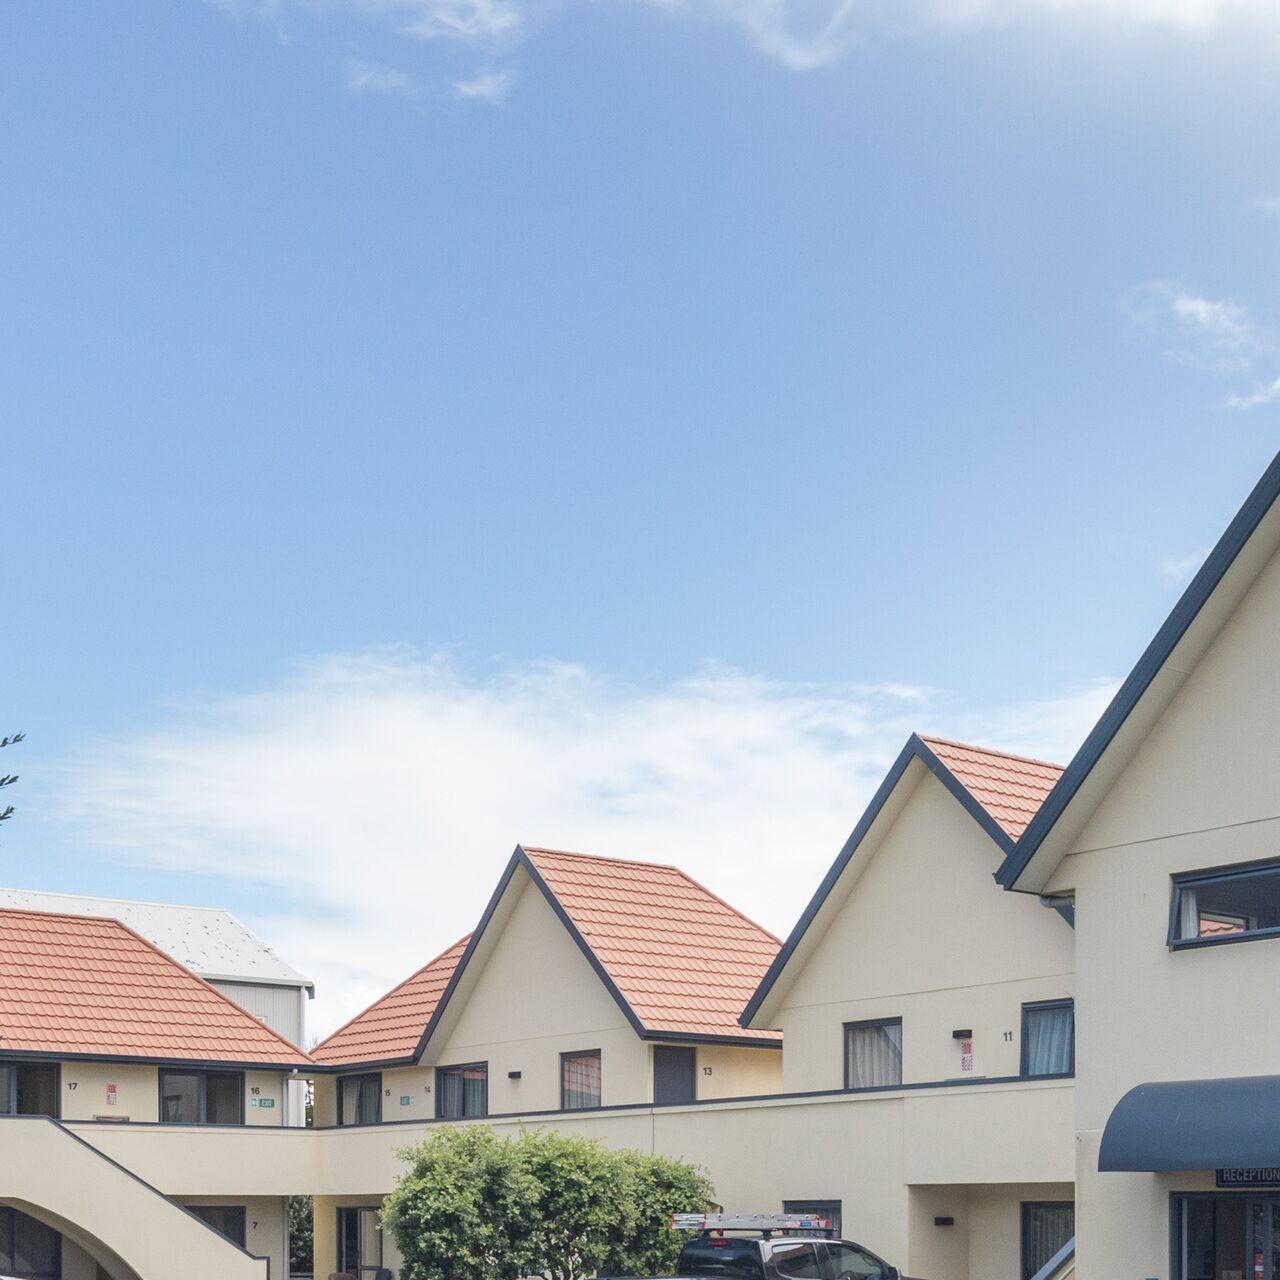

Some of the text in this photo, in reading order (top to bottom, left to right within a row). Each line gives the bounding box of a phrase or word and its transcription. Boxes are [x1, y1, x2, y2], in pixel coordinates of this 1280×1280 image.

[1003, 1031, 1013, 1042] 11
[703, 1067, 713, 1076] 13
[67, 1082, 78, 1090] 17
[251, 1087, 261, 1095] 16
[1223, 1168, 1280, 1181] RECEPTION
[252, 1221, 258, 1229] 7
